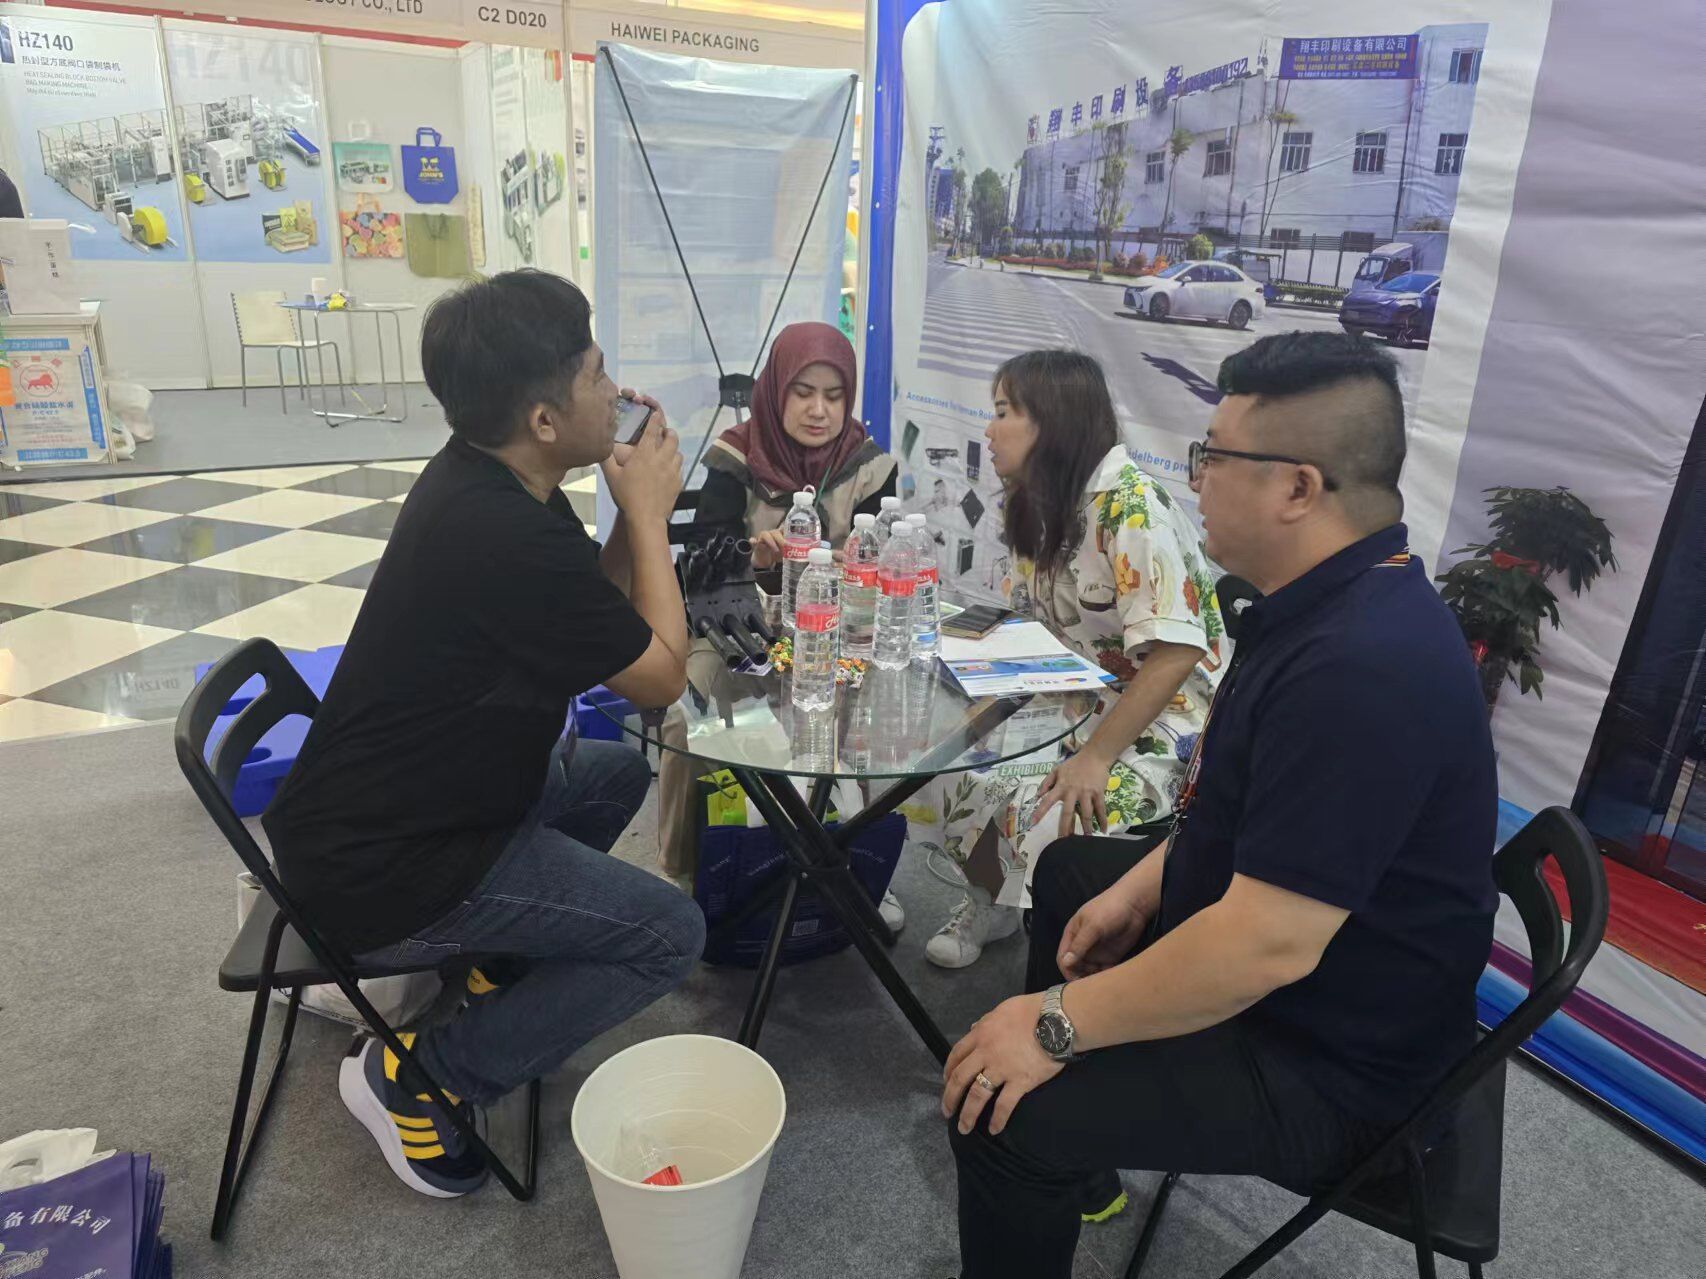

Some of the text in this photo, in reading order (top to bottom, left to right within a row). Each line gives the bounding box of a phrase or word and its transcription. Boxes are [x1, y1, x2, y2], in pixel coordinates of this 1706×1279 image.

[478, 6, 547, 28] C2 D020
[18, 31, 74, 51] HZ140
[611, 22, 760, 53] HAIWEI PACKAGING
[1300, 37, 1407, 54] 翔丰印刷设备有限公司
[1001, 762, 1053, 776] EXHIBITOR
